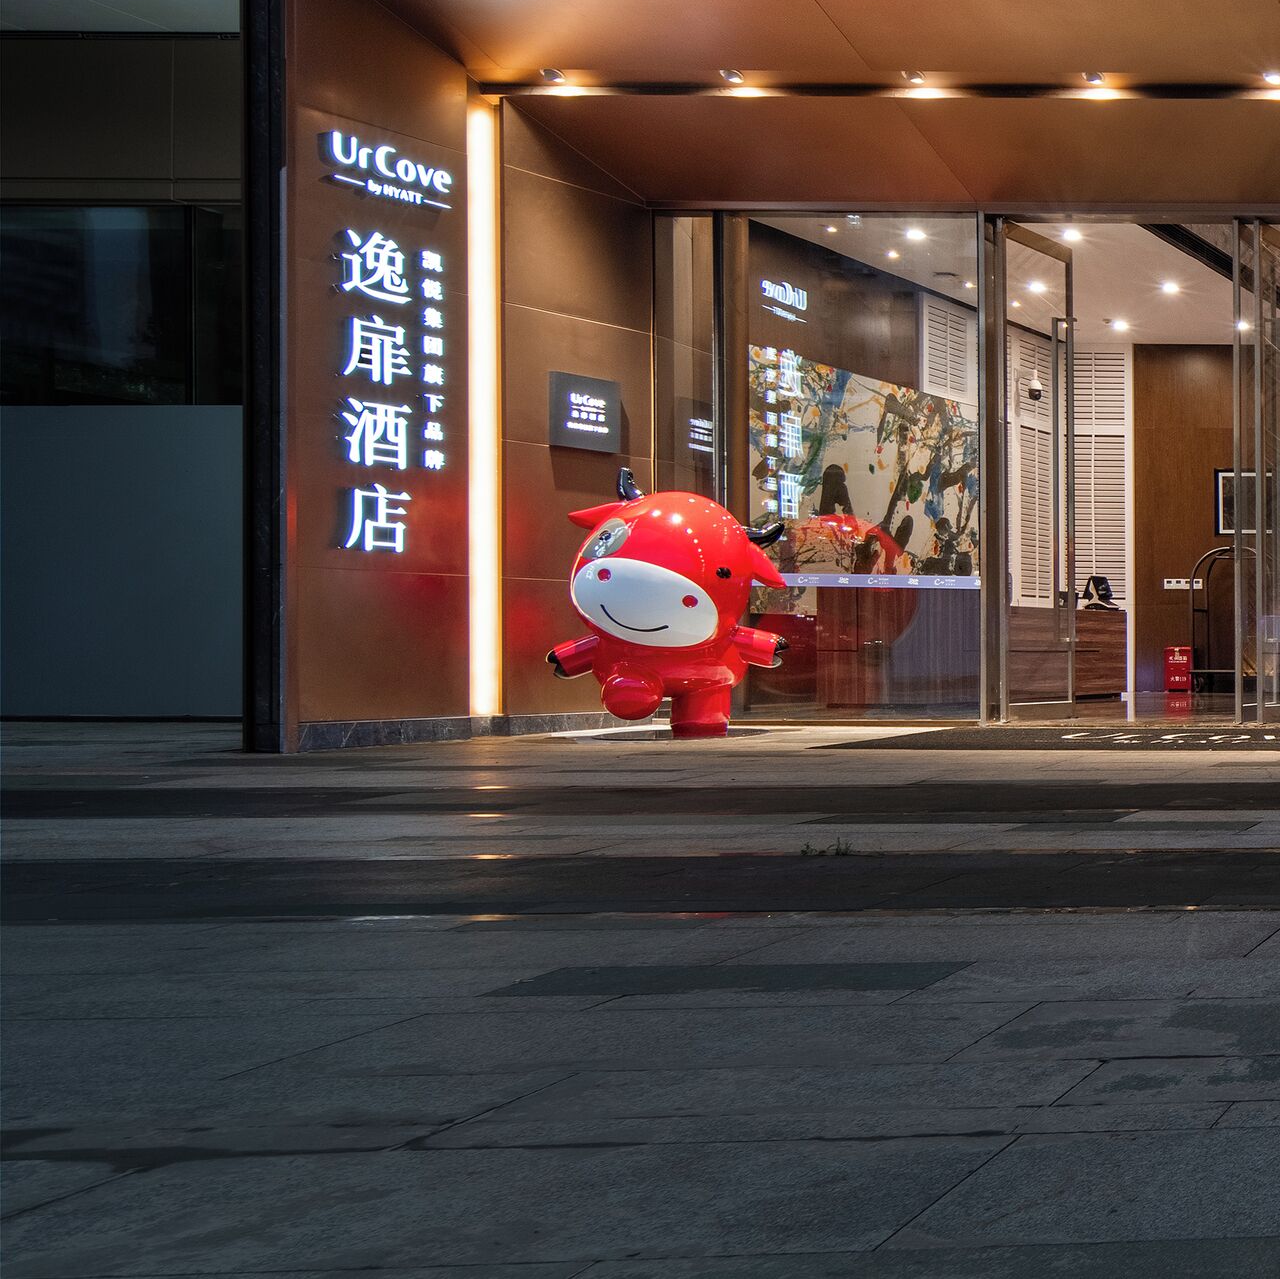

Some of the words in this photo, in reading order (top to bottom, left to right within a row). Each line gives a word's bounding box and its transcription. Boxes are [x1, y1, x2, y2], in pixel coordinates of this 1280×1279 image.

[331, 130, 453, 193] UrCove
[366, 179, 383, 195] by
[382, 184, 424, 205] HYATT
[341, 228, 413, 554] 逸扉酒店
